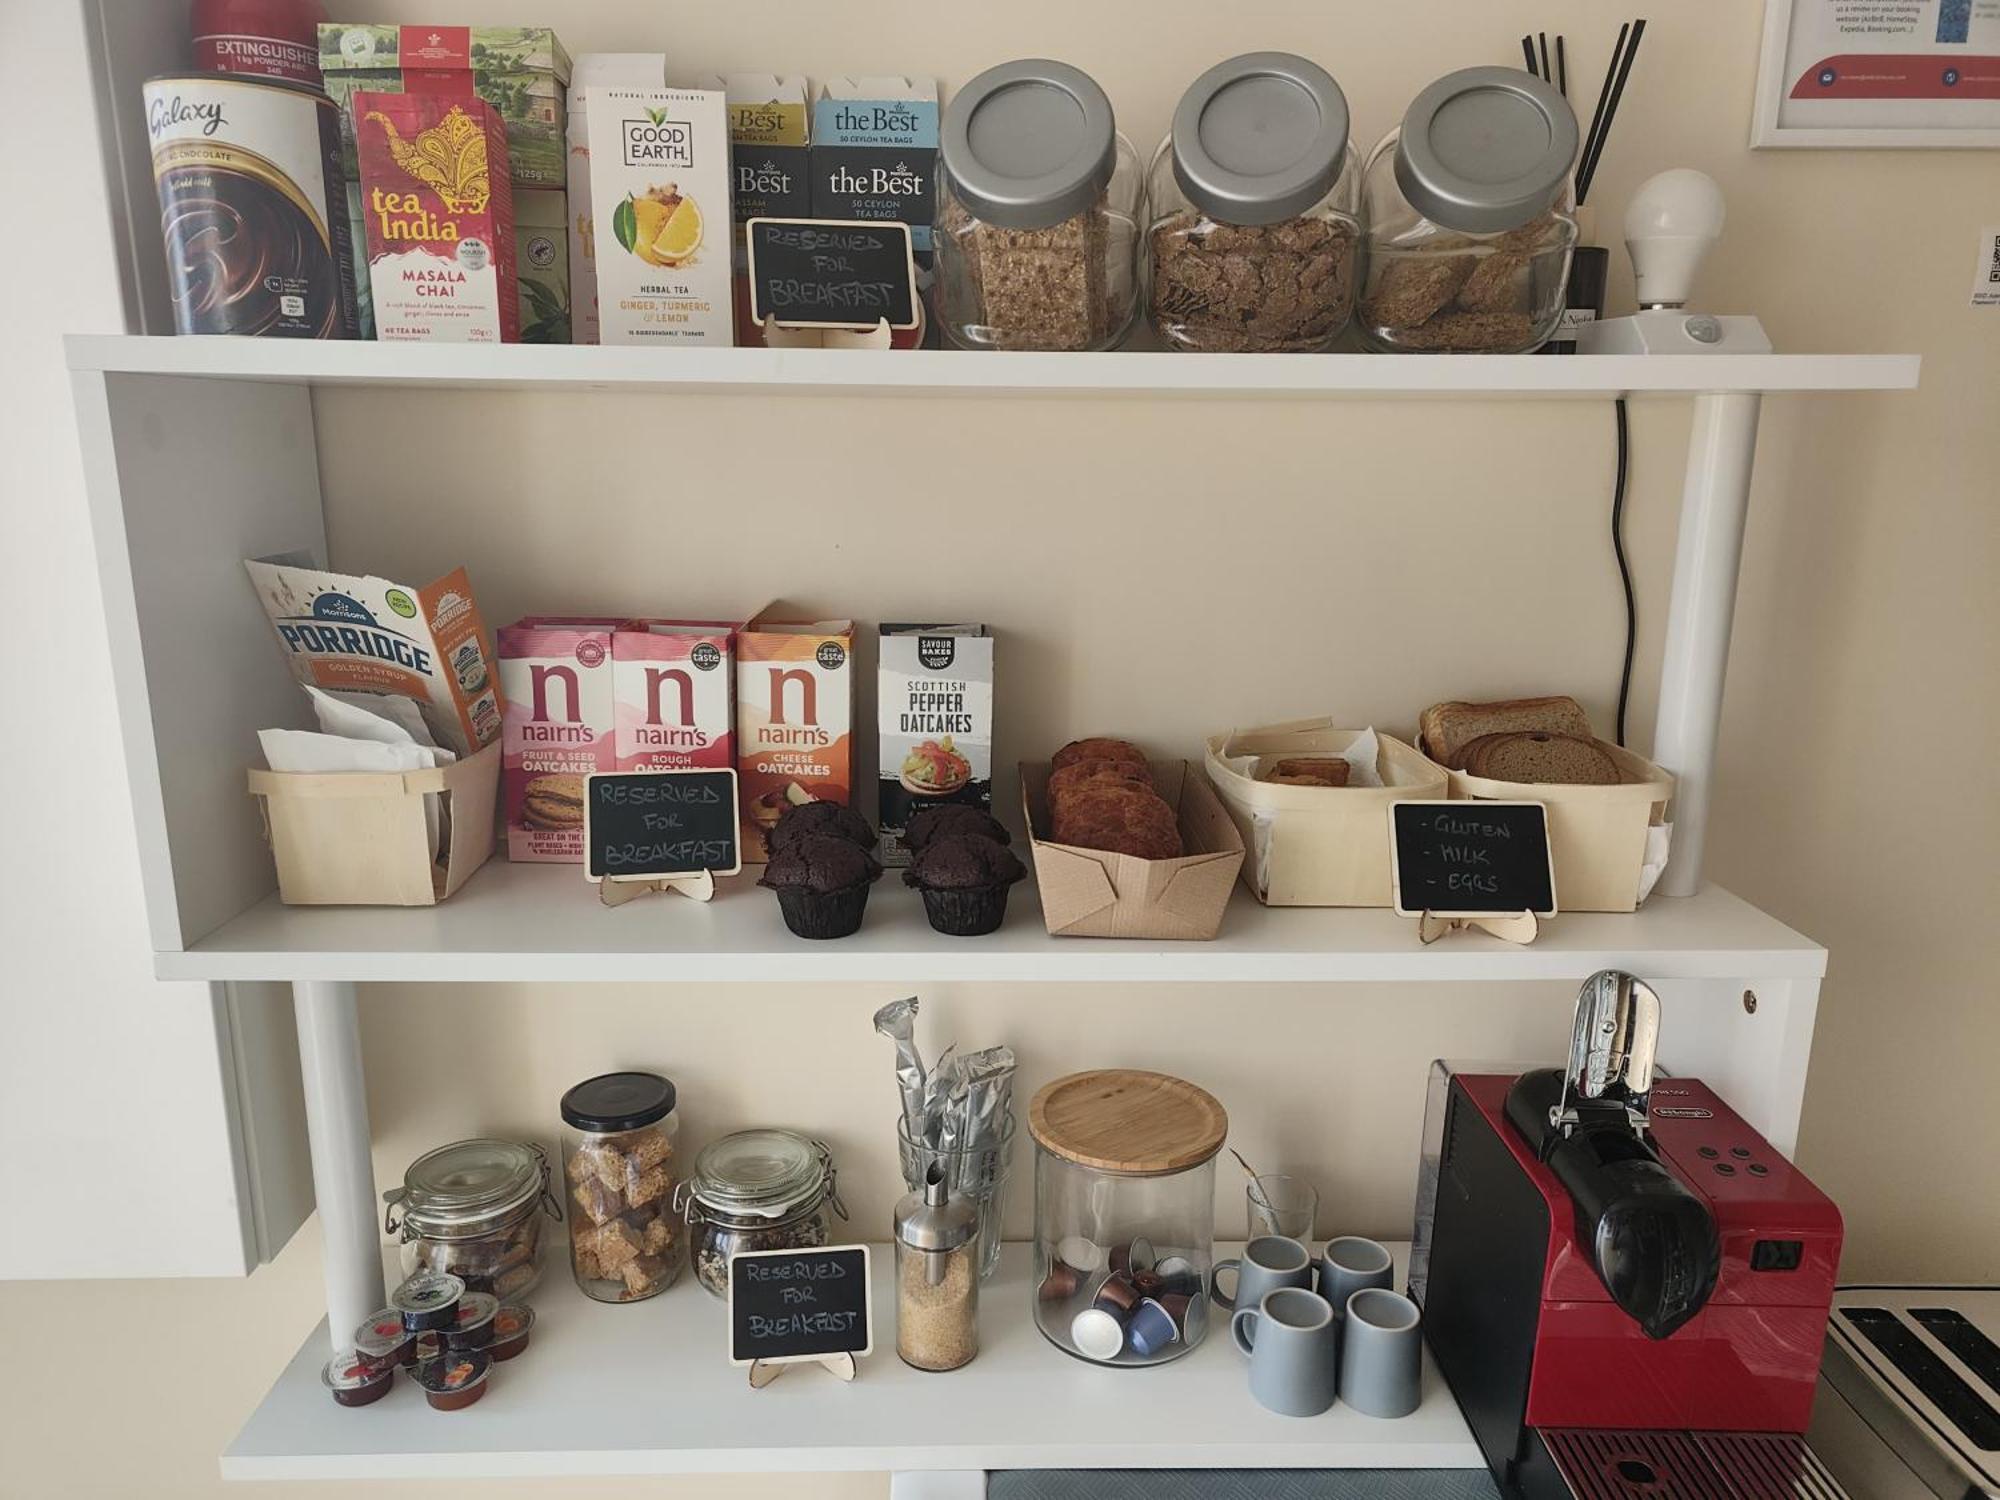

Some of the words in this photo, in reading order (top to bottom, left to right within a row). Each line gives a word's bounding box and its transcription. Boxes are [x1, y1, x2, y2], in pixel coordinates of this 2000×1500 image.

[216, 40, 319, 67] EXTINGUISHE
[254, 56, 289, 69] POWDER
[150, 96, 229, 138] Galaxy
[740, 109, 786, 132] Best
[834, 106, 869, 131] the
[873, 107, 920, 131] Best
[630, 127, 685, 143] GOOD
[840, 135, 849, 143] 50
[850, 135, 878, 143] CEYLON
[179, 150, 232, 161] CHOCOLATE
[739, 167, 791, 194] Best
[830, 165, 868, 194] the
[870, 168, 924, 196] Best
[372, 186, 424, 214] tea
[852, 200, 862, 208] 50
[864, 200, 900, 209] CEYLON
[855, 209, 872, 218] TEA
[873, 210, 898, 219] BAGS
[379, 209, 461, 242] India
[766, 226, 884, 251] RESERVED
[810, 254, 855, 273] FOR
[401, 269, 467, 284] MASALA
[415, 284, 455, 298] CHAI
[640, 285, 671, 295] HERBAL
[675, 286, 689, 295] TEA
[768, 278, 895, 309] BREAKFAST
[620, 300, 659, 312] GINGER,
[661, 301, 712, 312] TURMERIC
[656, 314, 689, 323] LEMON
[396, 327, 410, 335] TEA
[411, 327, 431, 335] BAGS
[321, 607, 367, 621] Morrisons
[430, 598, 474, 634] PORRIDGE
[277, 624, 434, 677] PORRIDGE
[921, 640, 952, 649] SAVOUR
[693, 653, 720, 662] taste
[818, 652, 845, 662] taste
[328, 663, 371, 674] GOLDEN
[373, 667, 408, 681] SYRUP
[529, 664, 583, 723] n
[907, 681, 967, 692] SCOTTISH
[644, 667, 696, 727] n
[768, 667, 819, 726] n
[909, 692, 963, 712] PEPPER
[522, 723, 594, 742] nairn's
[900, 713, 972, 733] OATCAKES
[635, 727, 707, 747] nairn's
[758, 727, 829, 746] nairn's
[522, 751, 554, 761] FRUIT
[556, 752, 566, 761] &
[567, 752, 596, 762] SEED
[651, 754, 692, 765] ROUGH
[773, 754, 814, 764] CHEESE
[522, 760, 597, 773] OATCAKES
[757, 763, 831, 776] OATCAKES
[600, 783, 720, 805] RESERVED
[641, 812, 684, 831] FOR
[1434, 814, 1511, 839] GLUTEN
[533, 832, 554, 841] GREAT
[567, 833, 580, 841] THE
[605, 839, 732, 865] BREAKFAST
[1440, 843, 1491, 865] MILK
[1448, 873, 1499, 896] EGGS
[746, 1261, 847, 1281] RESERVED
[780, 1286, 817, 1304] FOR
[748, 1311, 857, 1338] BREAKFAST
